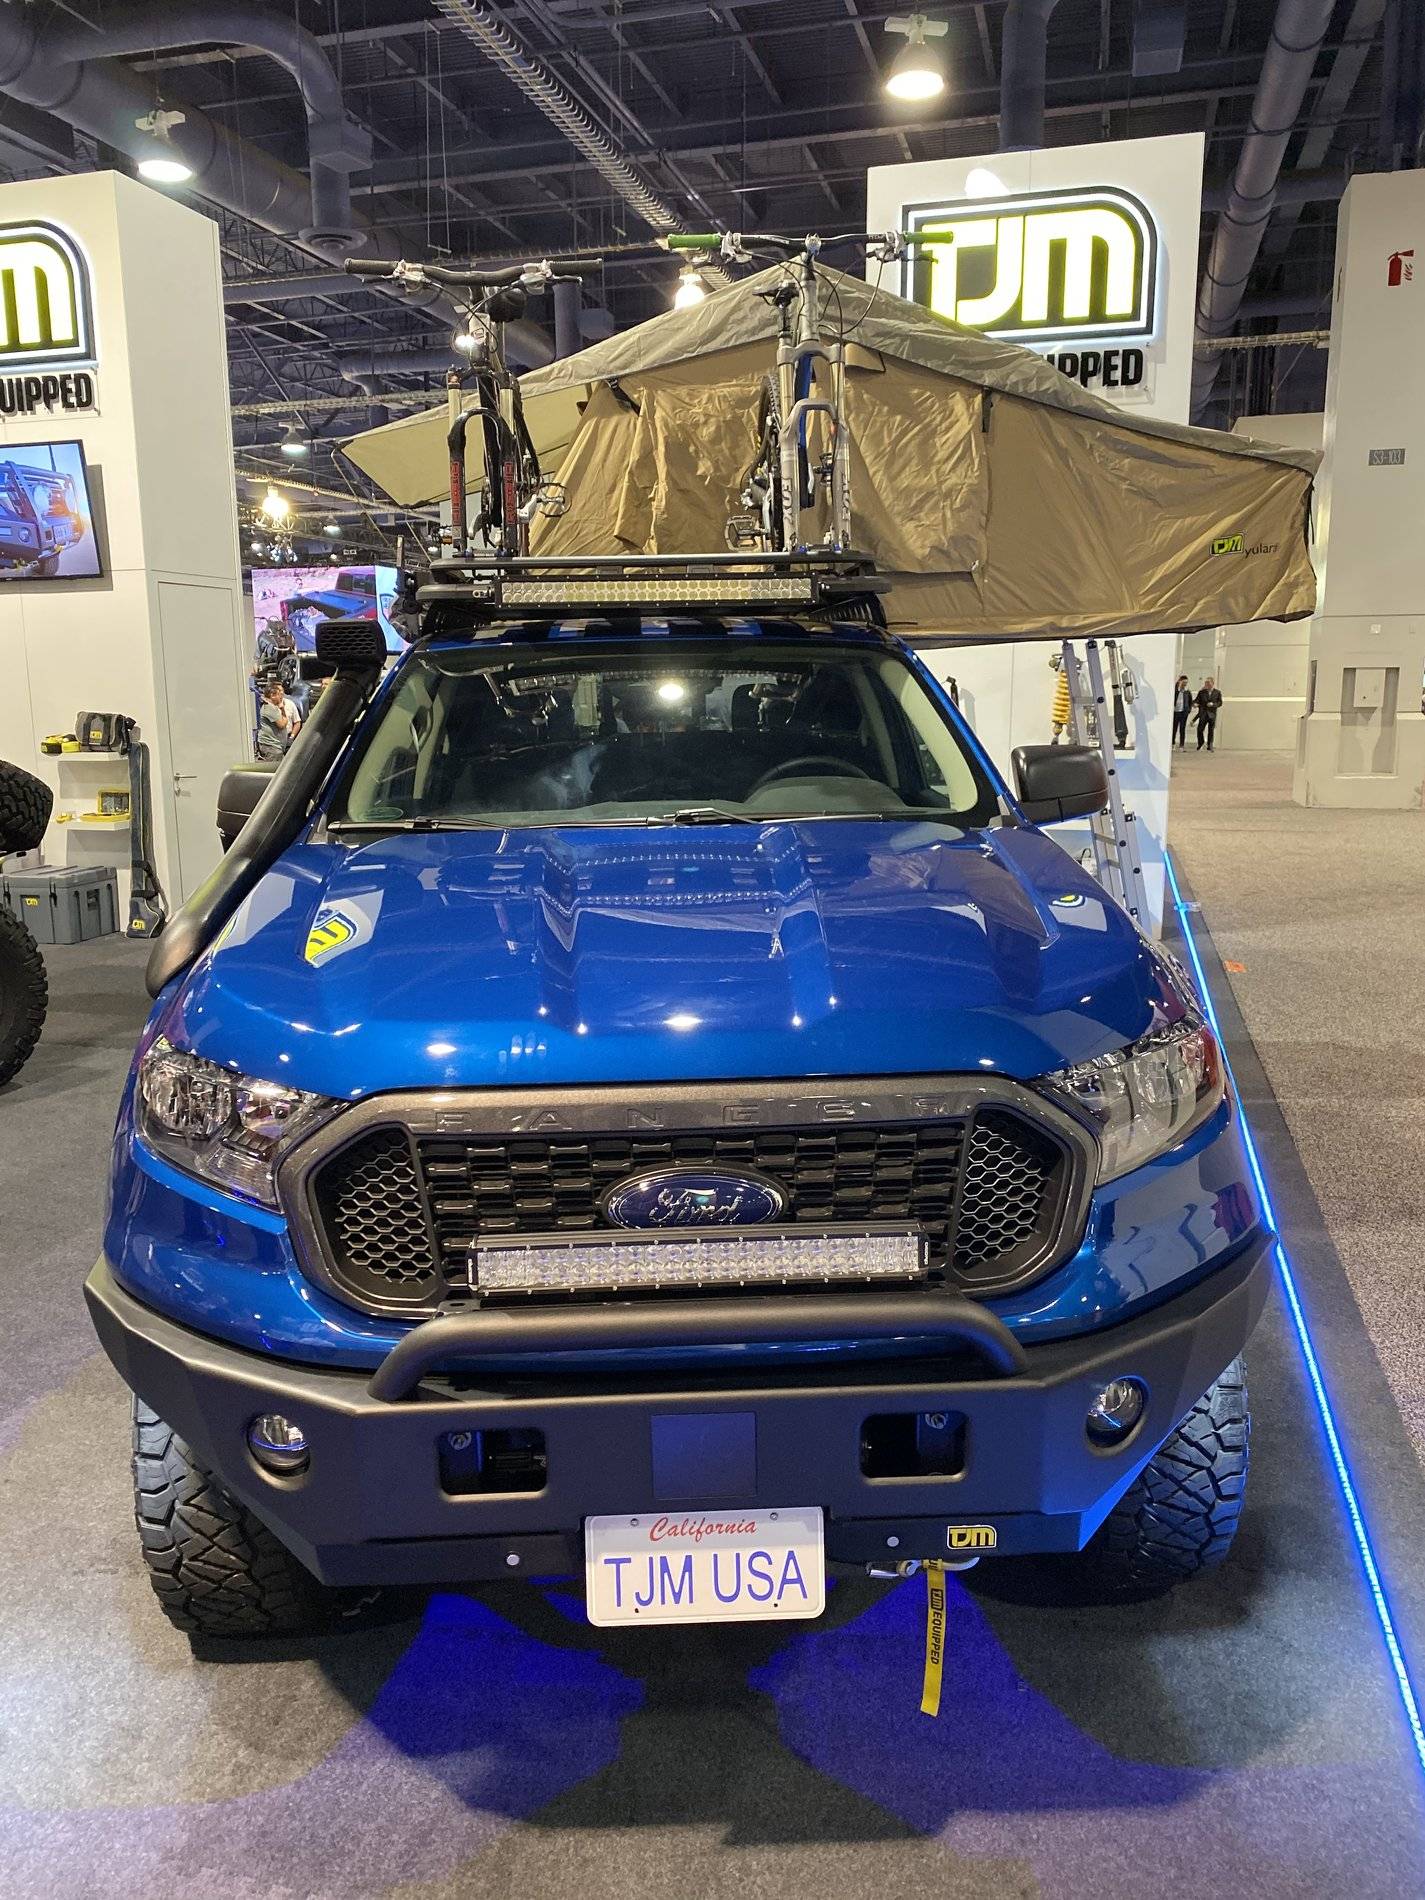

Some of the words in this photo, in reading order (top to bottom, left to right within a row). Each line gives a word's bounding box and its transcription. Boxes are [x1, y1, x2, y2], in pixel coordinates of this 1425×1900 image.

[1040, 348, 1144, 388] PPED
[0, 373, 93, 413] UIPPED
[649, 1187, 744, 1225] Ford
[650, 1516, 757, 1543] California
[949, 1527, 995, 1547] TJM
[604, 1554, 694, 1608] TJM
[713, 1550, 808, 1603] USA
[931, 1611, 943, 1665] EQUIPPED
